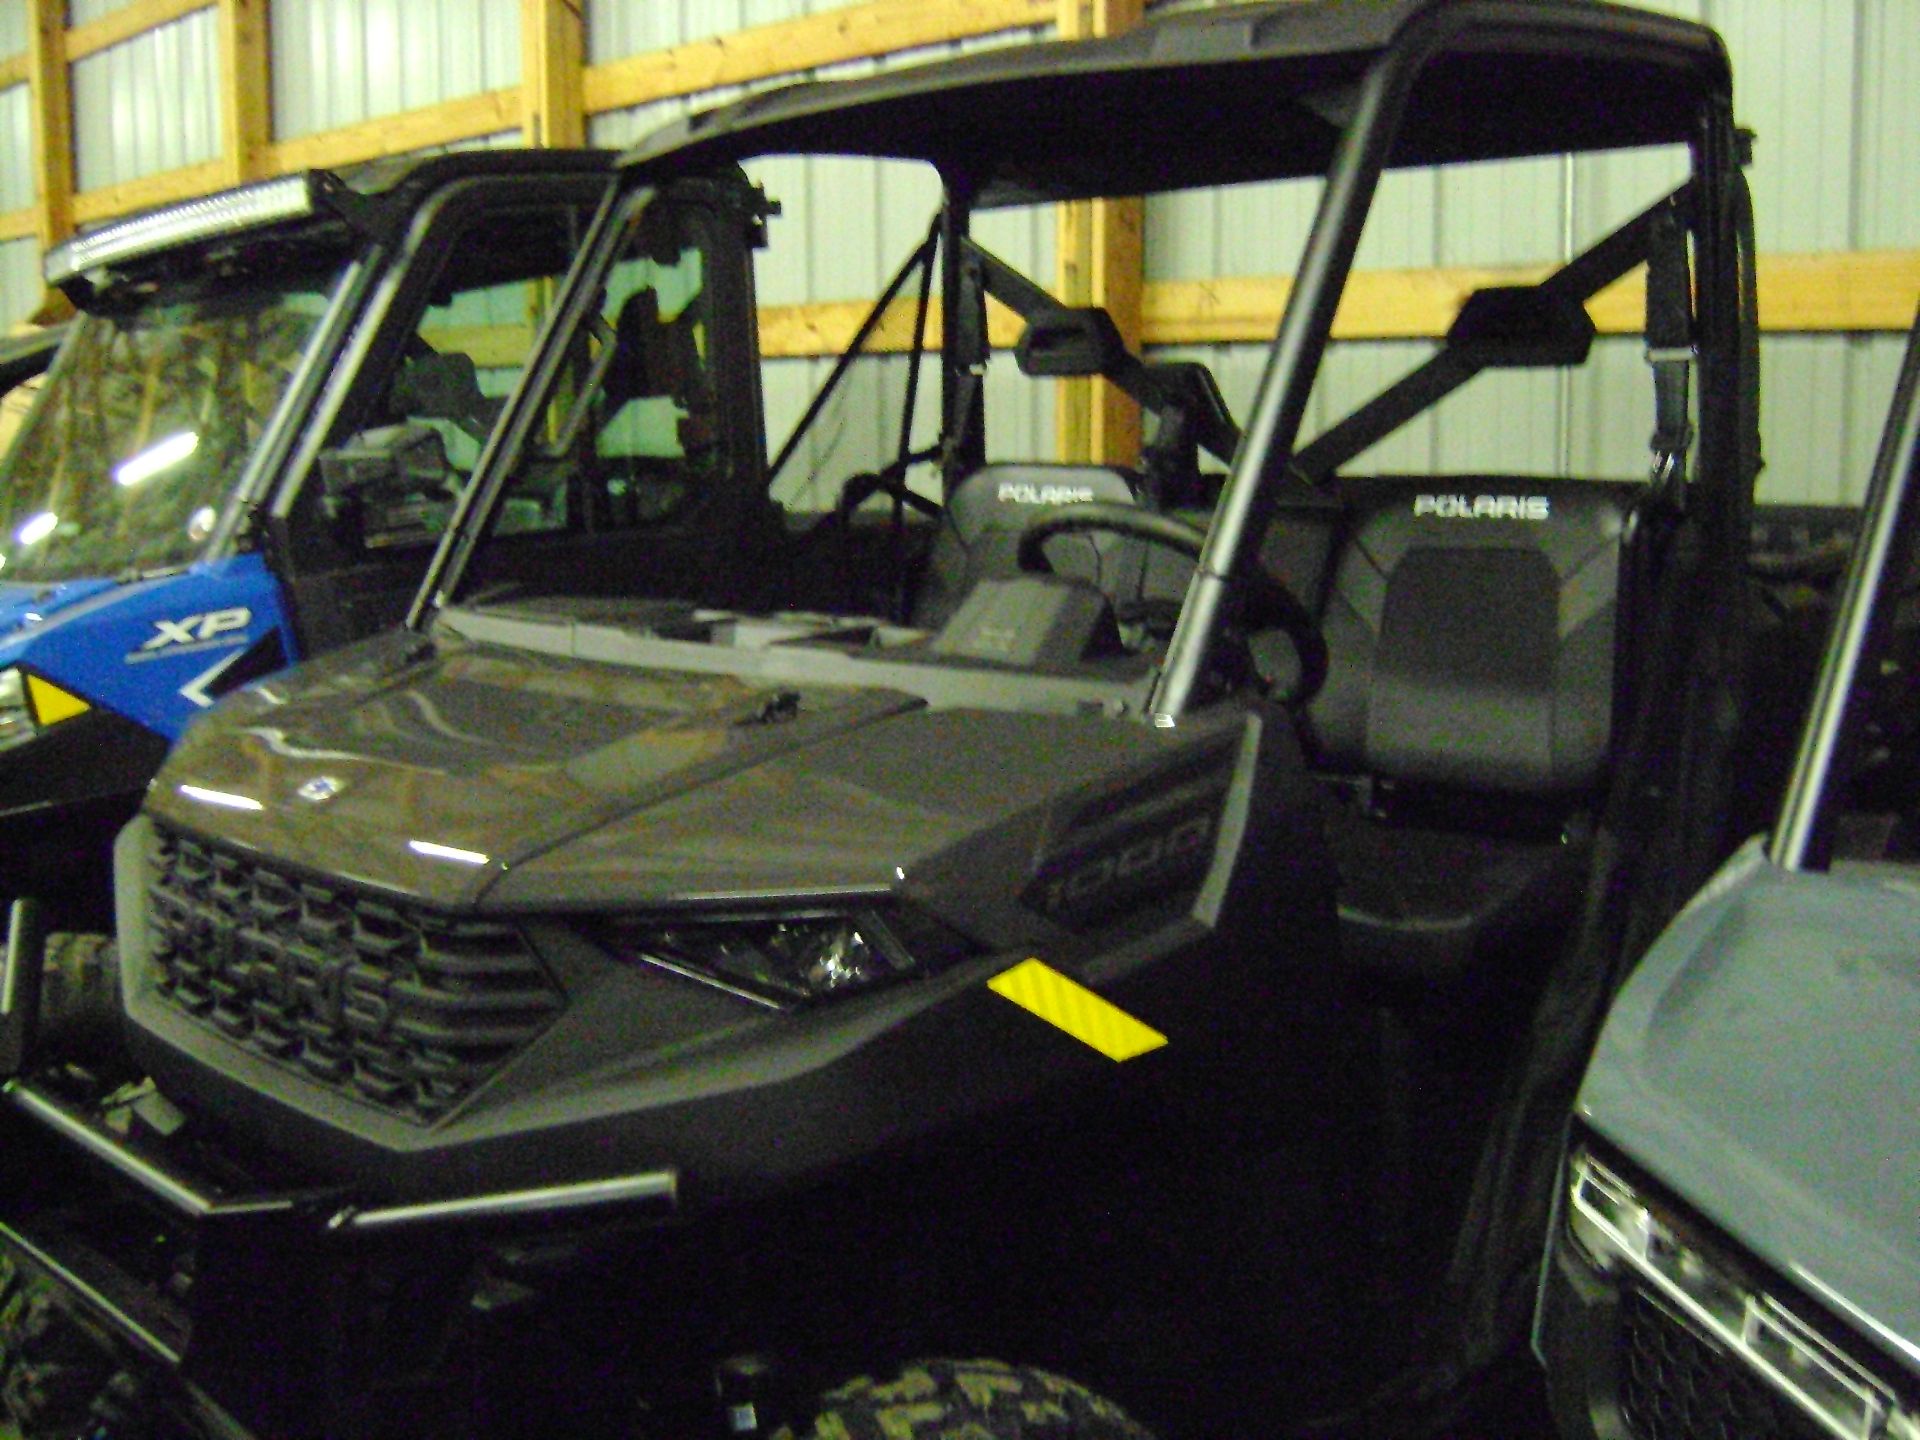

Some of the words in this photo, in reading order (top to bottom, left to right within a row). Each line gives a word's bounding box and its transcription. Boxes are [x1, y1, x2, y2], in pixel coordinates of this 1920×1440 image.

[997, 482, 1094, 505] POLARIS
[1413, 494, 1550, 520] POLARIS
[142, 607, 252, 650] XP
